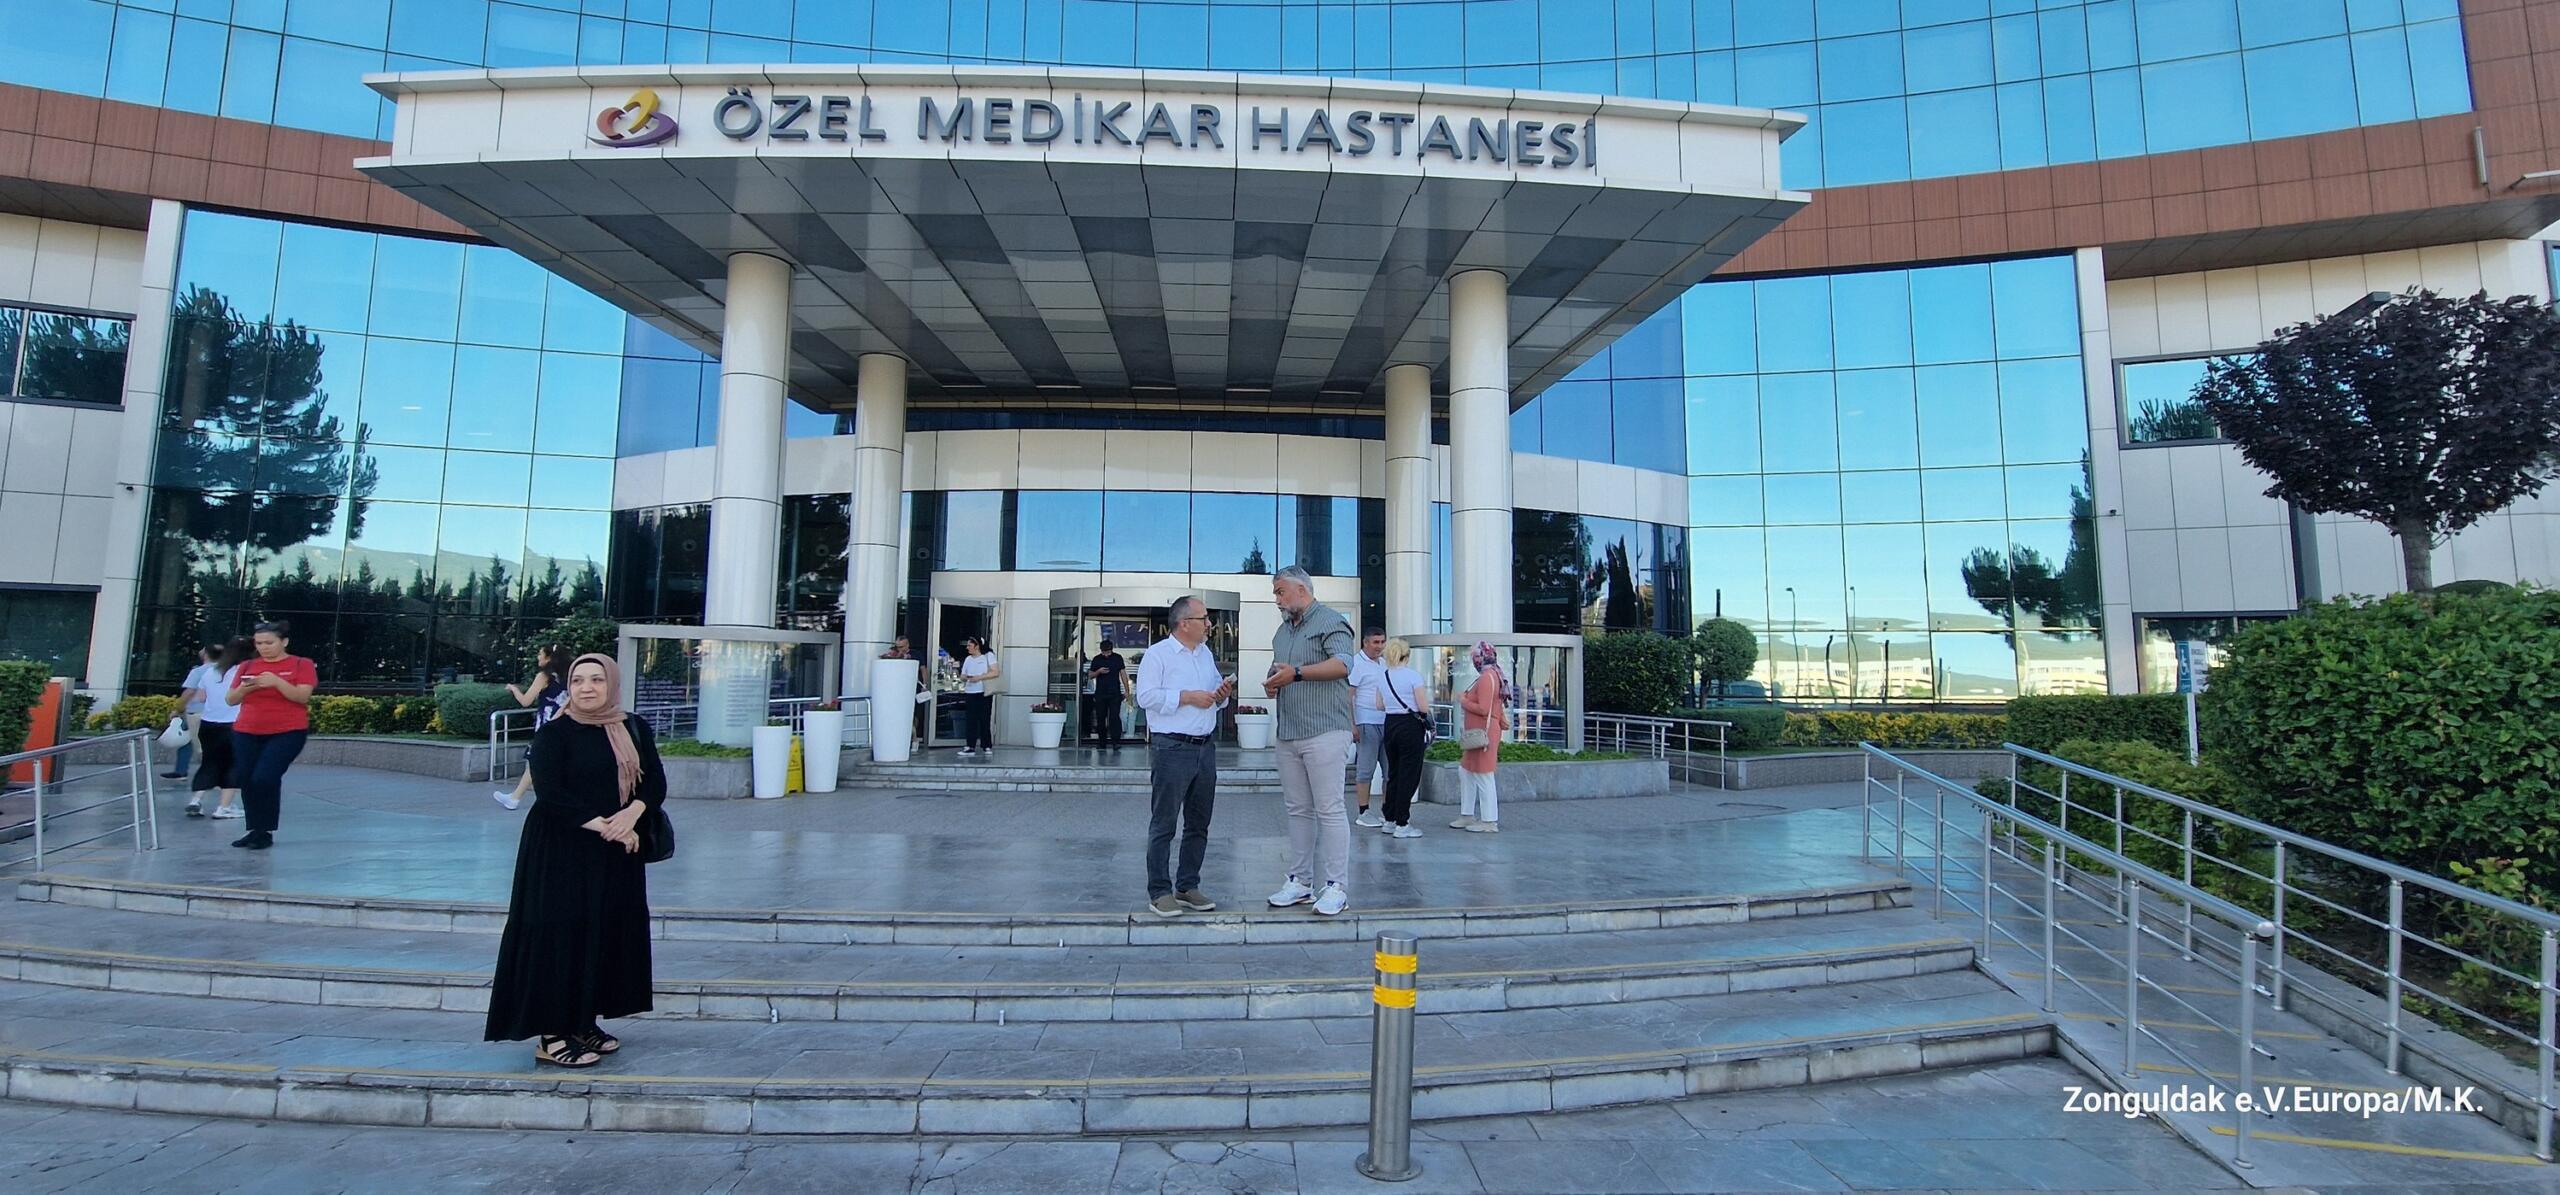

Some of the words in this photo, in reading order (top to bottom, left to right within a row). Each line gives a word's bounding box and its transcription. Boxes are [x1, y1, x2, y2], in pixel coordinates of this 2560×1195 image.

[713, 87, 887, 141] ÖZEL
[918, 93, 1224, 148] MEDİKAR
[1252, 106, 1596, 168] HASTANESİ
